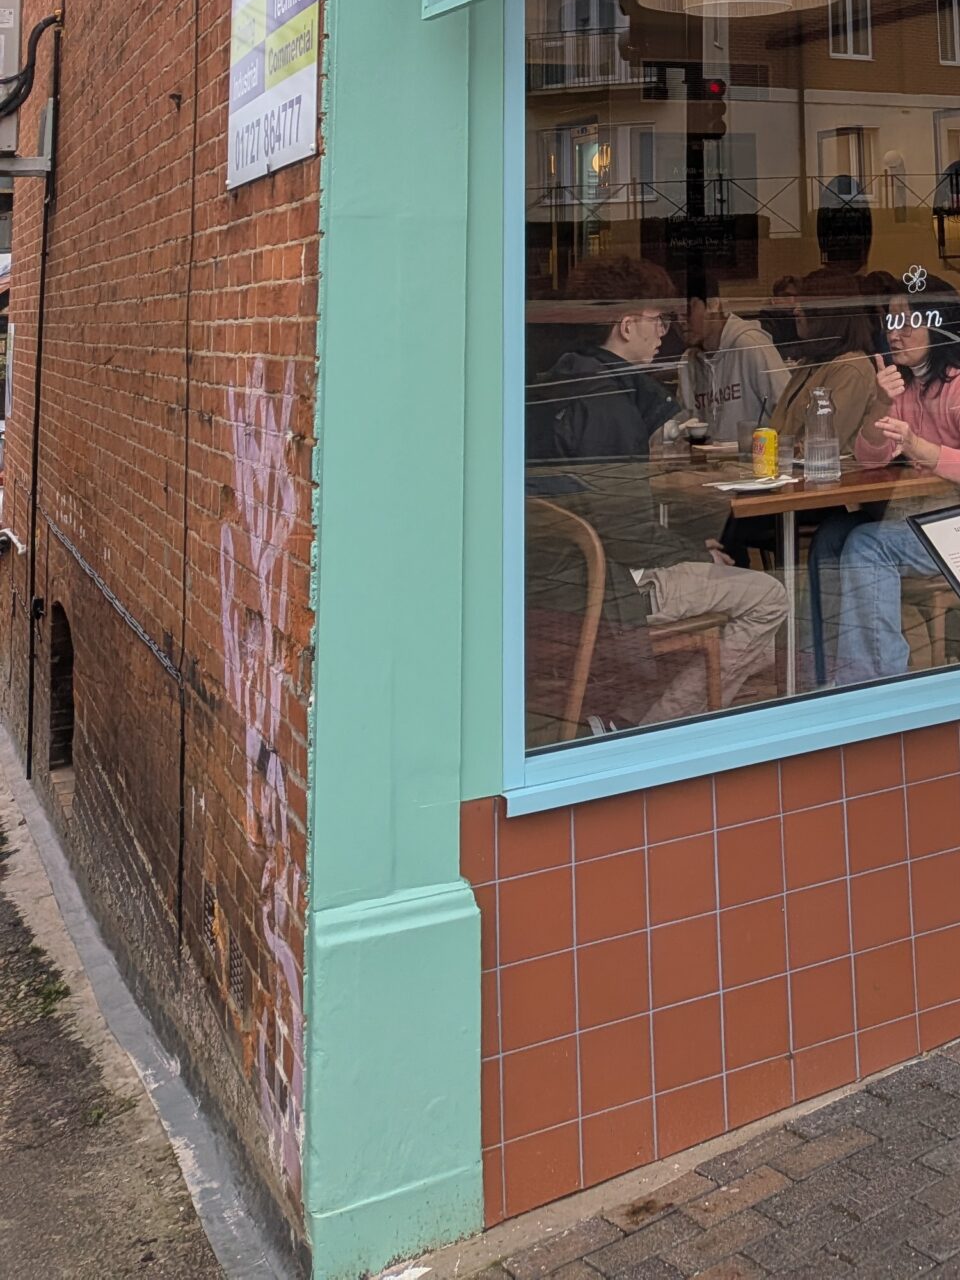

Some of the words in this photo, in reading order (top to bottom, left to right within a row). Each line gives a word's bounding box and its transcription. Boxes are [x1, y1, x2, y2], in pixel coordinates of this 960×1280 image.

[268, 19, 314, 75] Commercial
[235, 118, 261, 171] 01727
[264, 94, 302, 157] 864777
[886, 308, 943, 330] won
